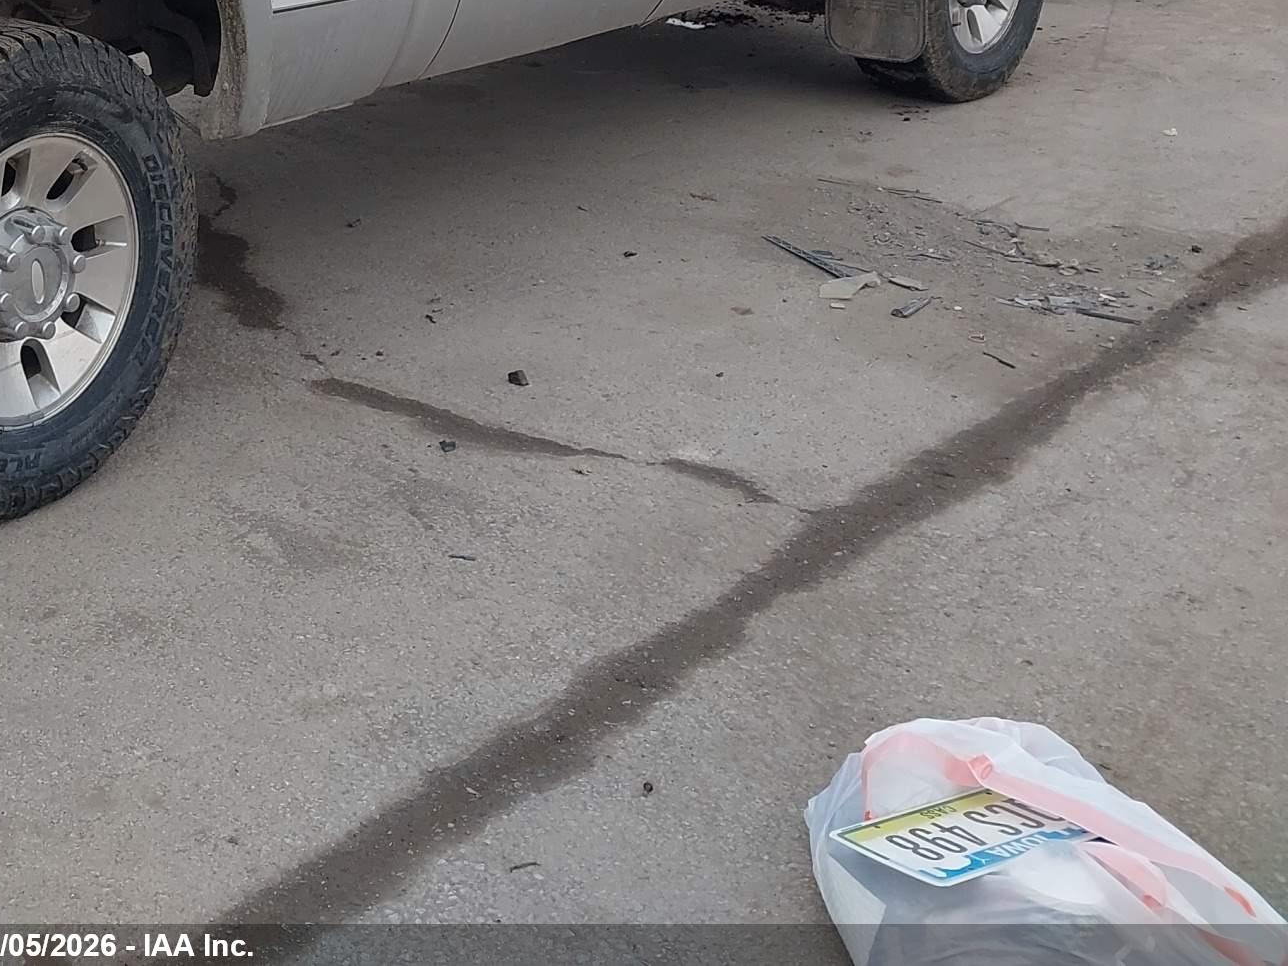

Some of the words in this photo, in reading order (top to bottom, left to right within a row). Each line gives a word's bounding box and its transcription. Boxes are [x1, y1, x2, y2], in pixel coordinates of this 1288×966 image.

[919, 804, 958, 821] CASS
[884, 821, 989, 862] 498
[987, 833, 1048, 859] IOWA
